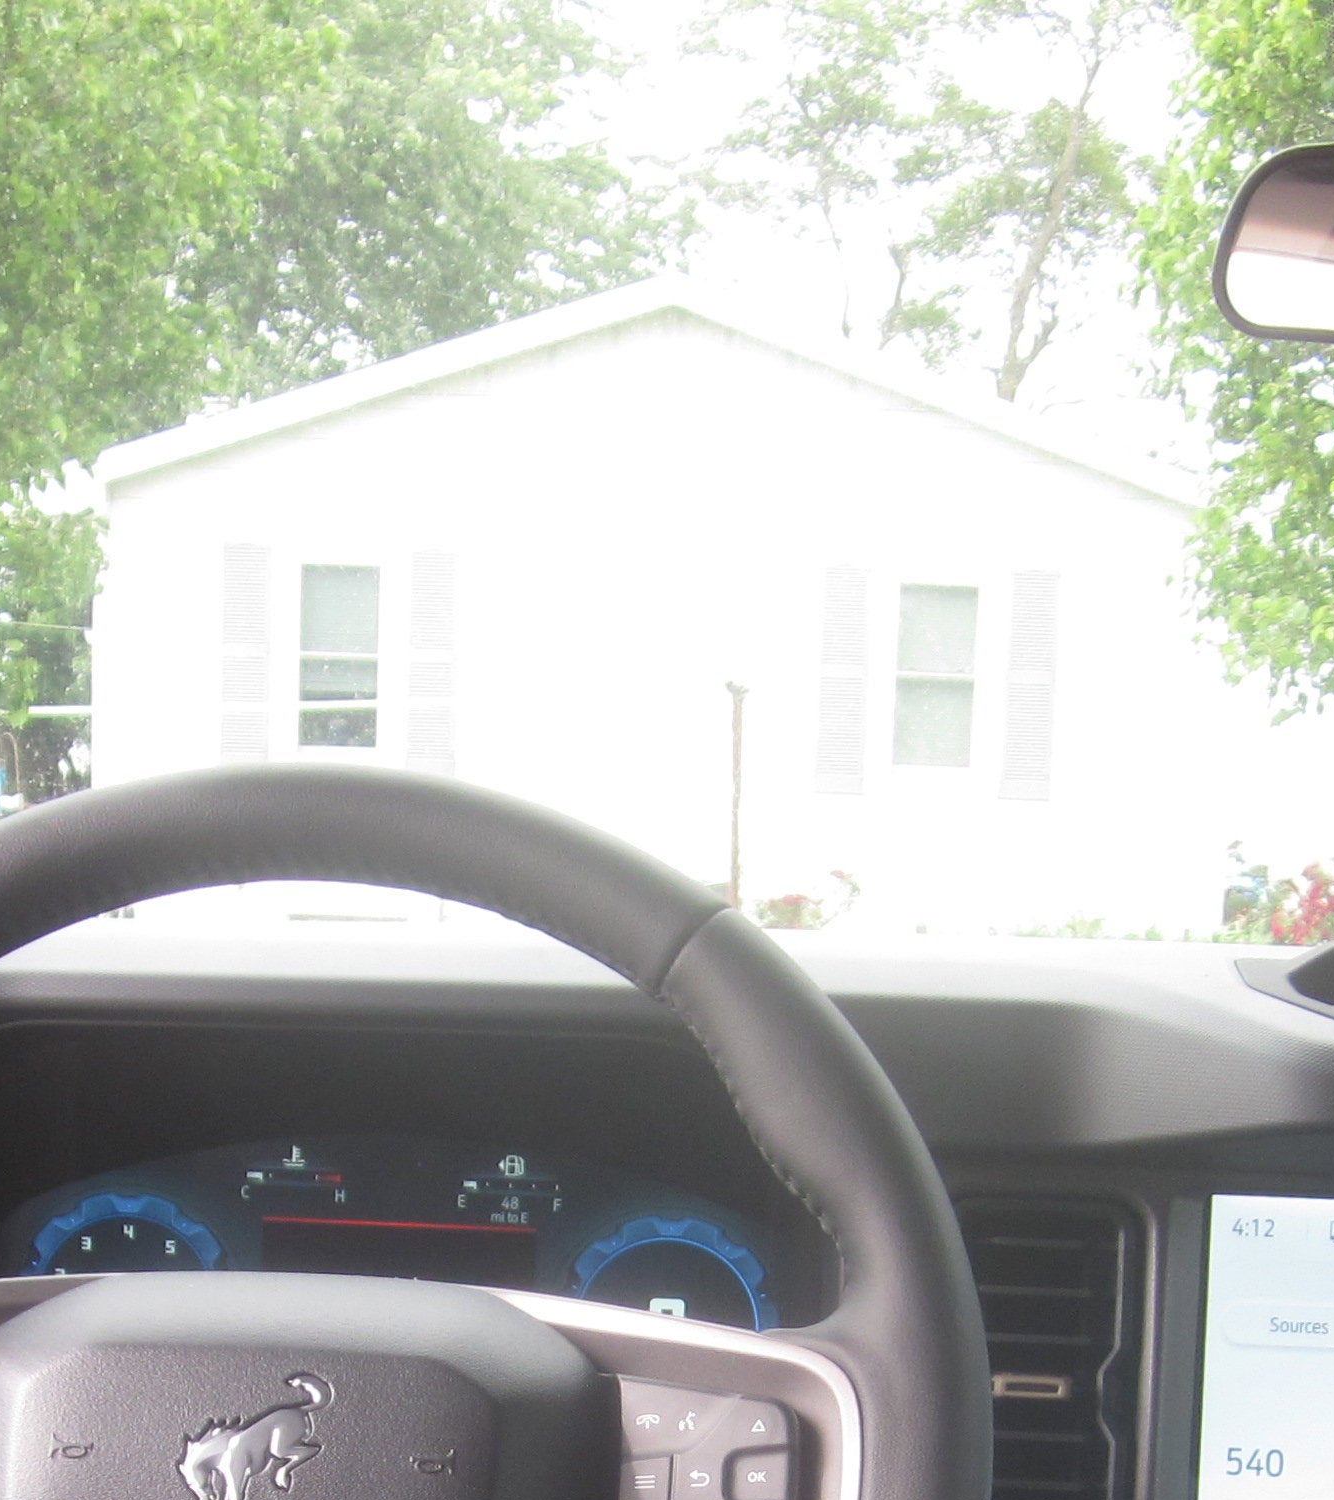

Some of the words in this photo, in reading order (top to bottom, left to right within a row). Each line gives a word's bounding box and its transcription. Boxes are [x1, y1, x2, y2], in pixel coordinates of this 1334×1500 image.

[241, 1185, 250, 1199] C
[334, 1189, 345, 1203] H
[457, 1194, 466, 1209] E
[501, 1196, 520, 1211] 48
[553, 1198, 562, 1213] F
[490, 1211, 506, 1223] mi
[508, 1212, 519, 1223] to
[520, 1212, 529, 1224] E
[123, 1224, 134, 1239] 4
[1232, 1218, 1276, 1239] 4:12
[81, 1236, 92, 1251] 3
[165, 1240, 176, 1255] 5
[1269, 1316, 1330, 1336] Sources
[1225, 1447, 1285, 1478] 540
[747, 1471, 767, 1483] OK
